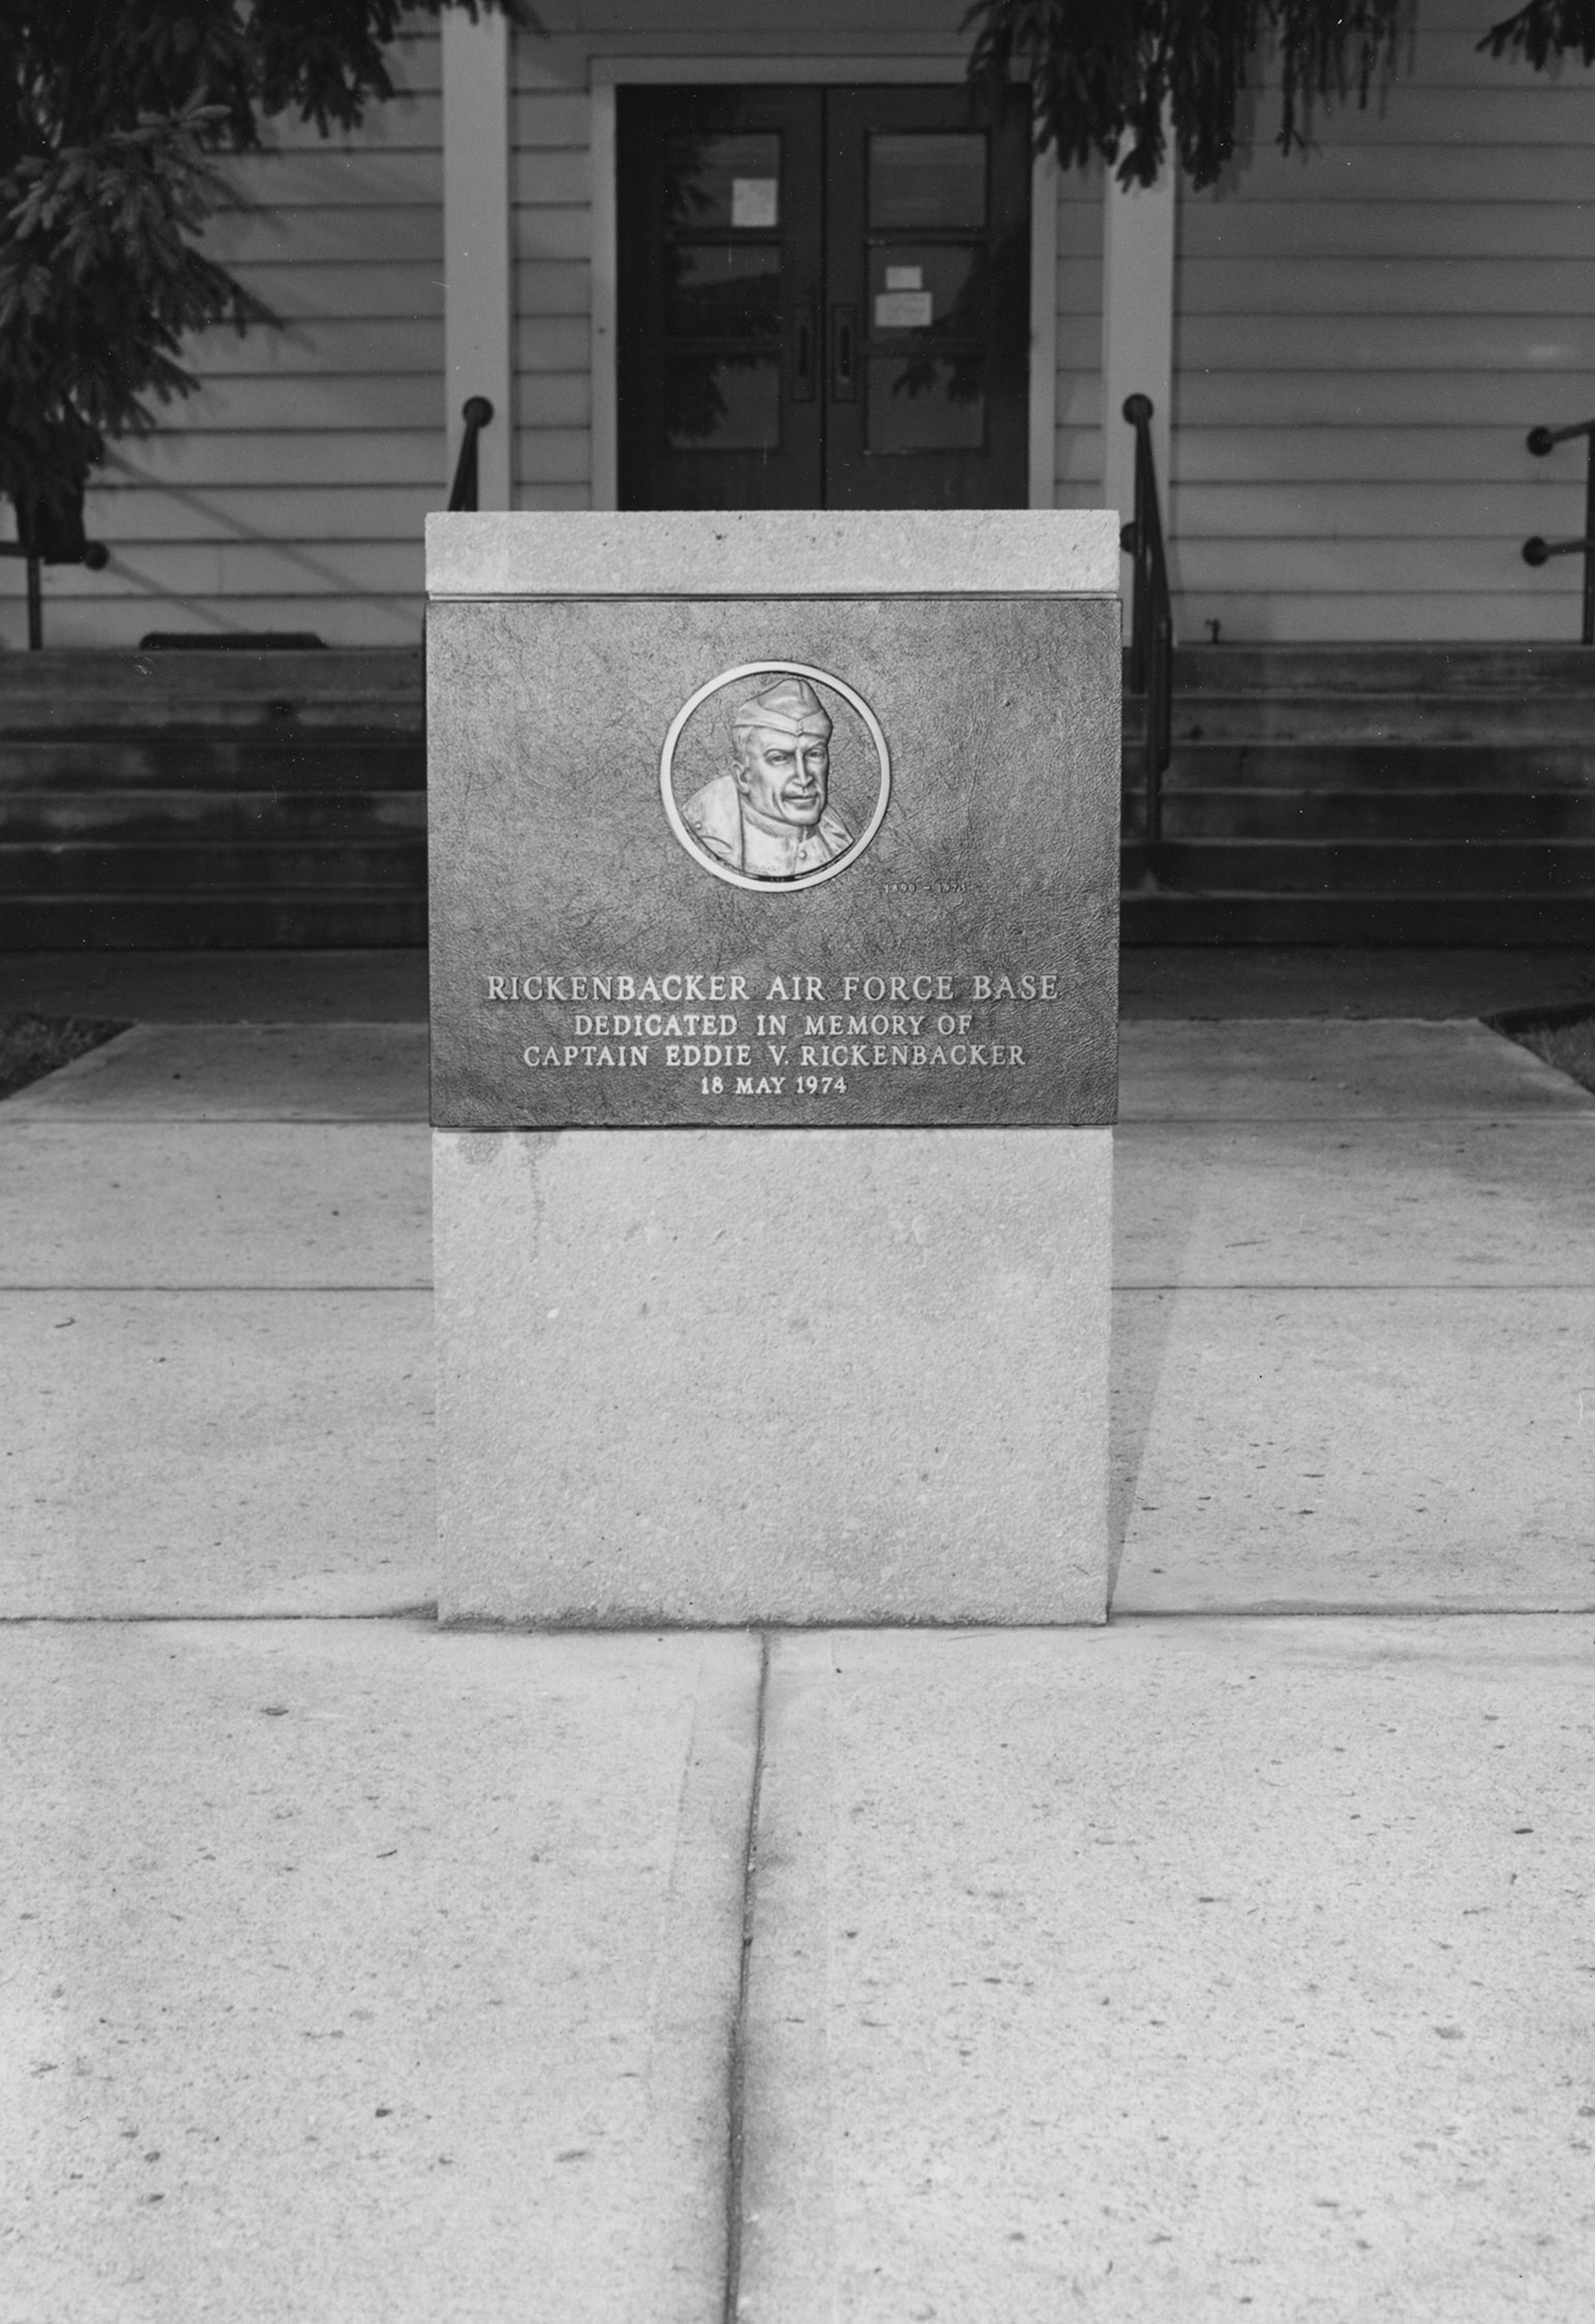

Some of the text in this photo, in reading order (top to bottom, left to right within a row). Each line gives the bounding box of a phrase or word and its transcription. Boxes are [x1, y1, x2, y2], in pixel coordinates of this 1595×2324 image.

[487, 975, 1057, 1000] RICKENBACKER AIR FORCE BASE
[575, 1014, 972, 1036] DEDICATED IN MEMORY OF
[524, 1044, 1026, 1066] CAPTAIN EDDIE V. RICKENBACKER
[701, 1076, 847, 1095] 18 MAY 1974
